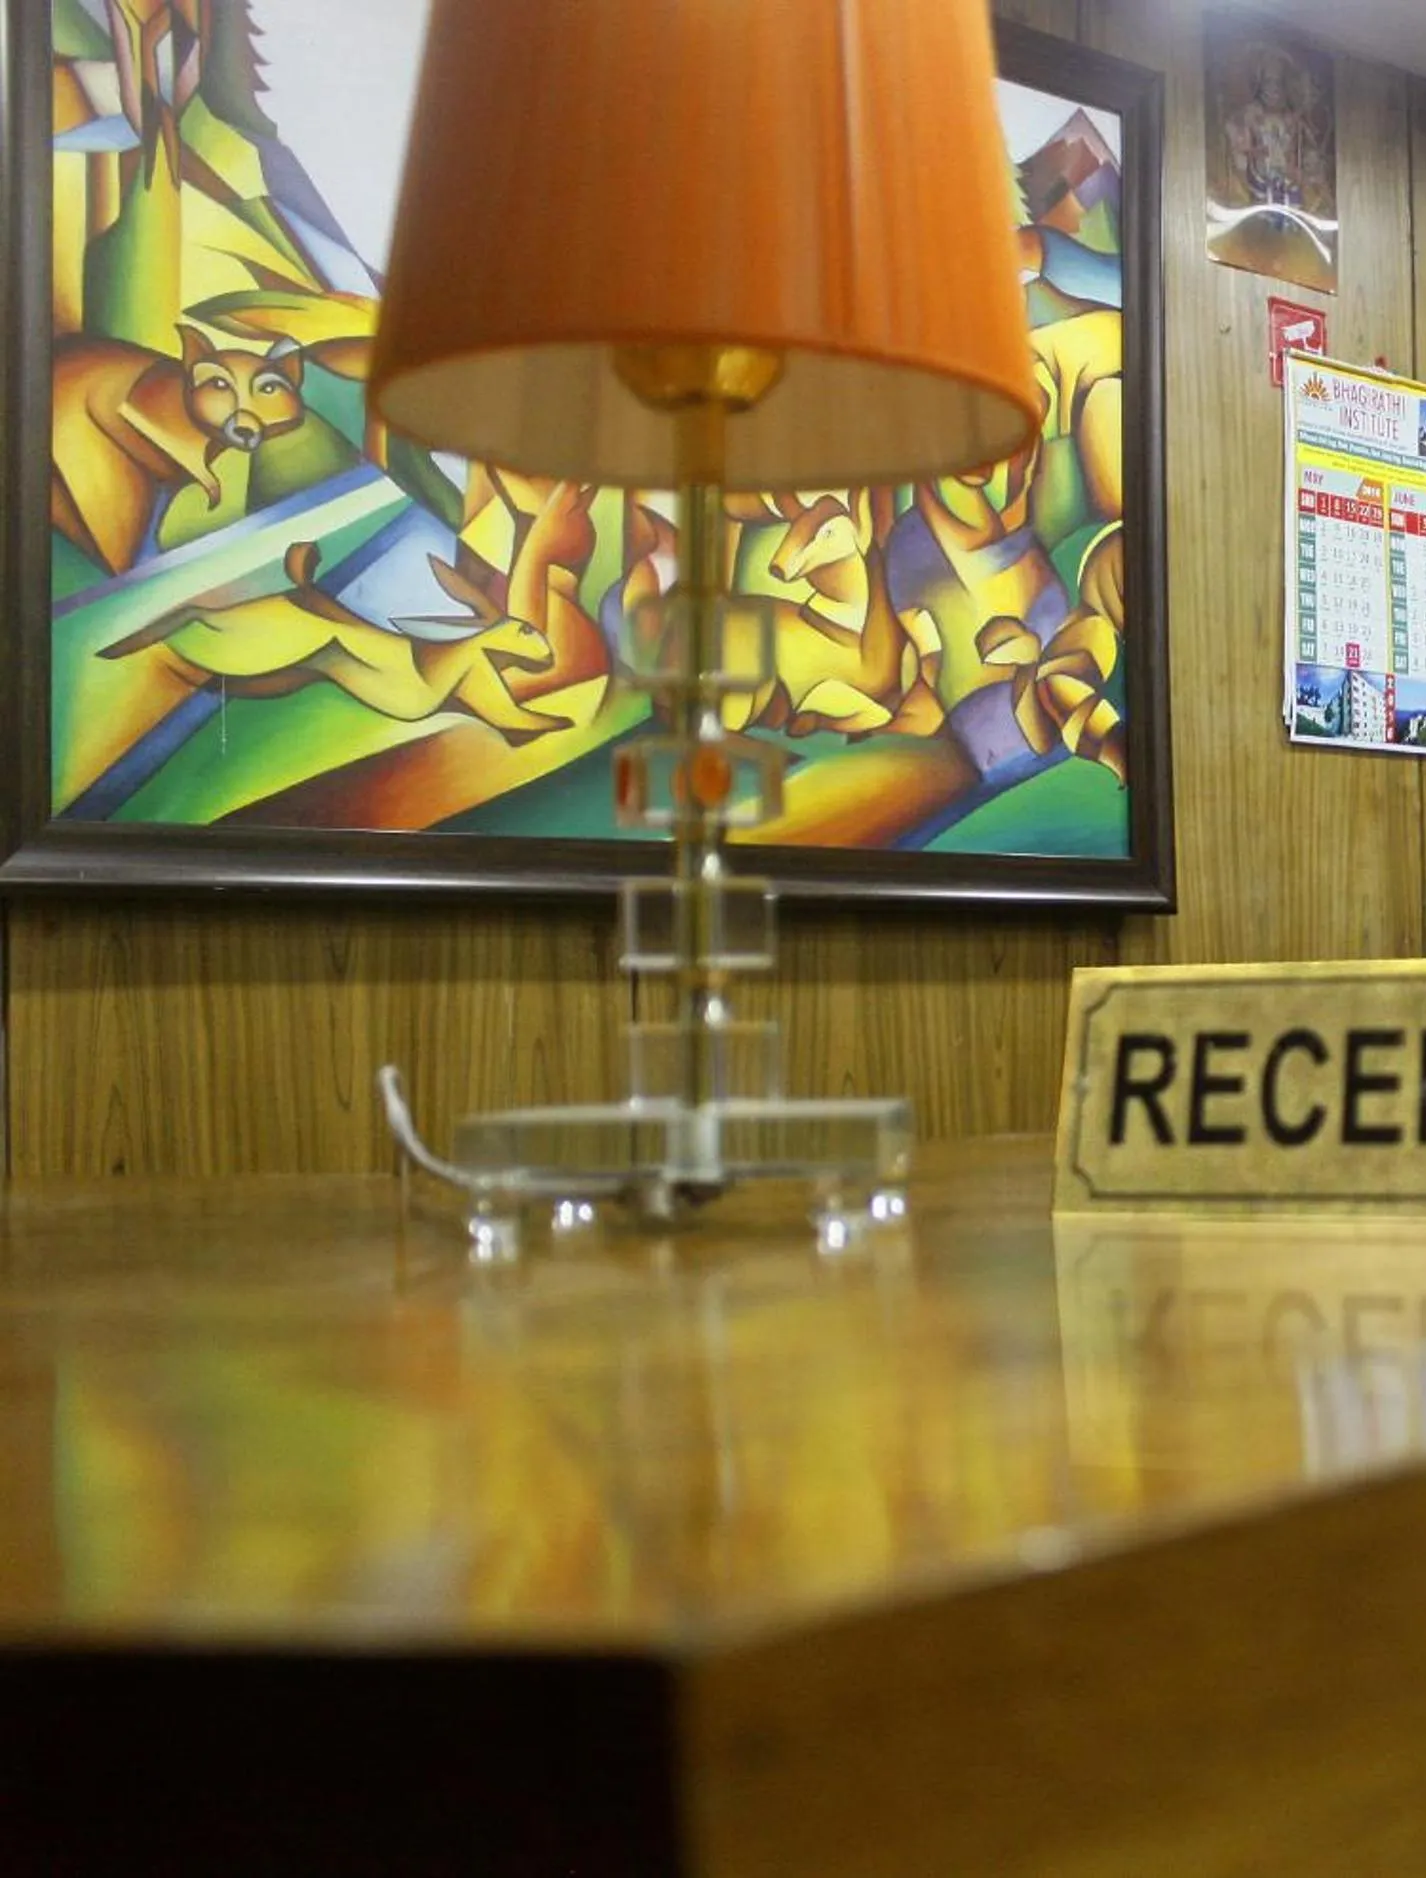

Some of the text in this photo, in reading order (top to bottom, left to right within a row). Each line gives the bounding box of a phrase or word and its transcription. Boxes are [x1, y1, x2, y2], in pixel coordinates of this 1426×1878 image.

[1334, 381, 1405, 420] BHAGIRATHI
[1340, 405, 1399, 440] INSTITUTE
[1304, 471, 1323, 485] MAY
[1394, 491, 1415, 506] JUNE
